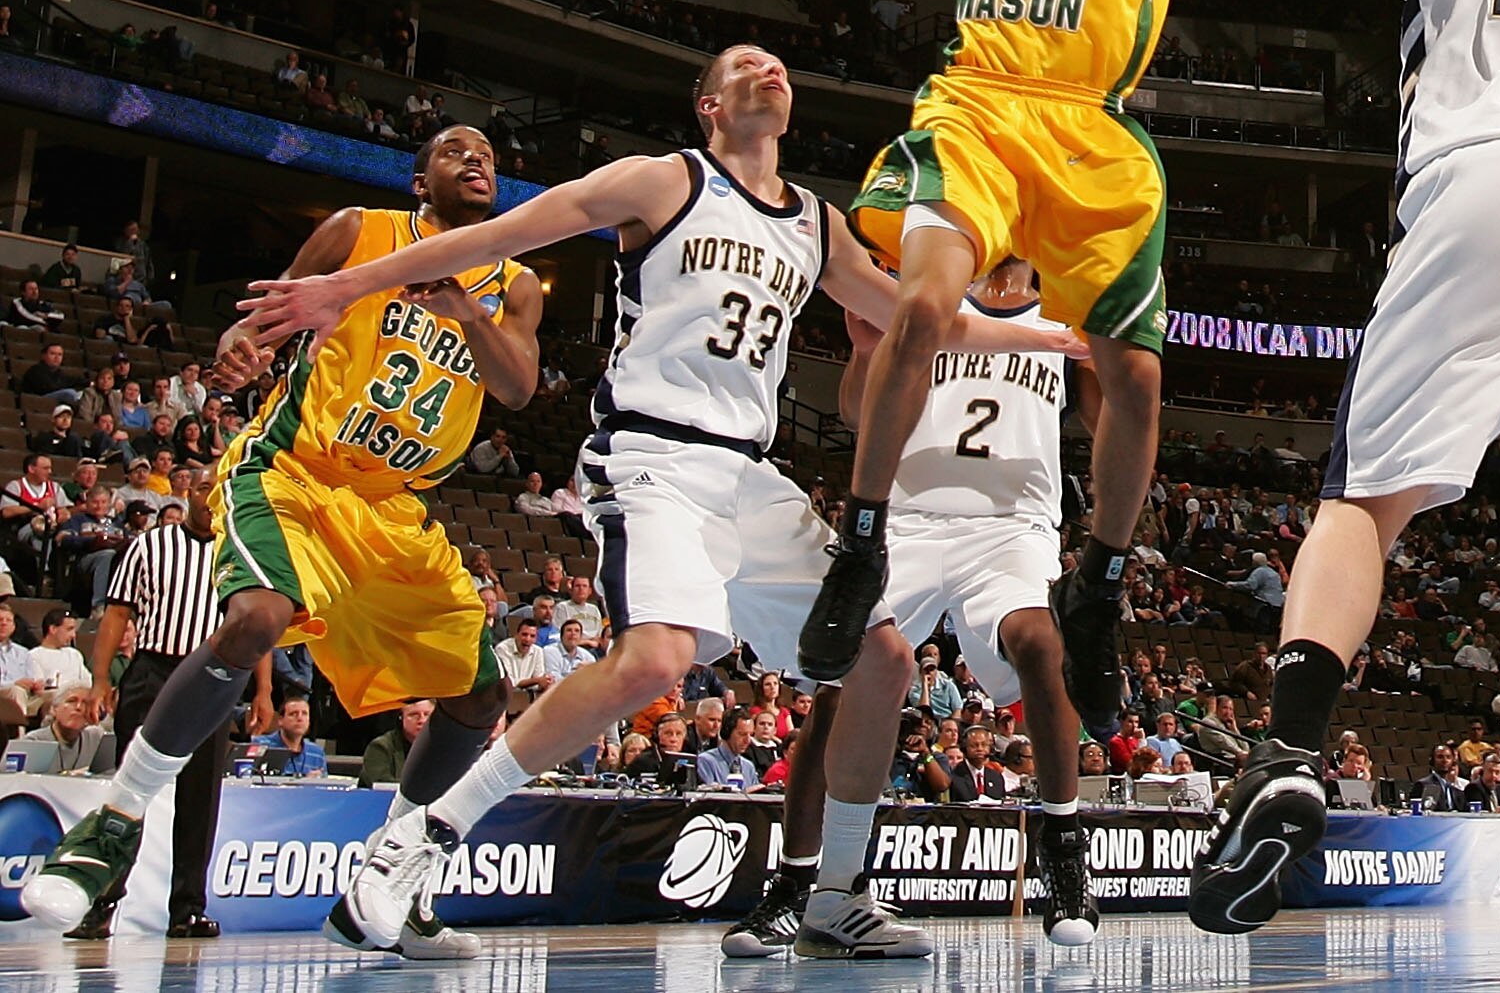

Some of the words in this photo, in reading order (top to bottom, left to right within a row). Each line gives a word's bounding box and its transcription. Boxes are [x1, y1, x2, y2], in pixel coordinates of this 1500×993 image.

[680, 237, 766, 278] NOTRE
[768, 257, 810, 316] DAM
[705, 290, 785, 371] 33
[1166, 309, 1231, 350] 2008
[1236, 319, 1308, 356] NCAA
[367, 350, 454, 438] 34
[931, 352, 995, 386] OTRE
[1002, 352, 1061, 406] DAME
[955, 397, 1001, 459] 2
[212, 841, 368, 898] GEORG
[432, 843, 556, 896] ASON
[873, 825, 957, 871] FIRST
[961, 827, 1028, 871] AND
[1324, 849, 1390, 886] NOTRE
[1392, 850, 1446, 885] DAME
[899, 878, 977, 901] UNIVERSITY
[979, 879, 1007, 901] AND
[1091, 877, 1128, 898] WEST
[1130, 877, 1191, 898] CONFEREN
